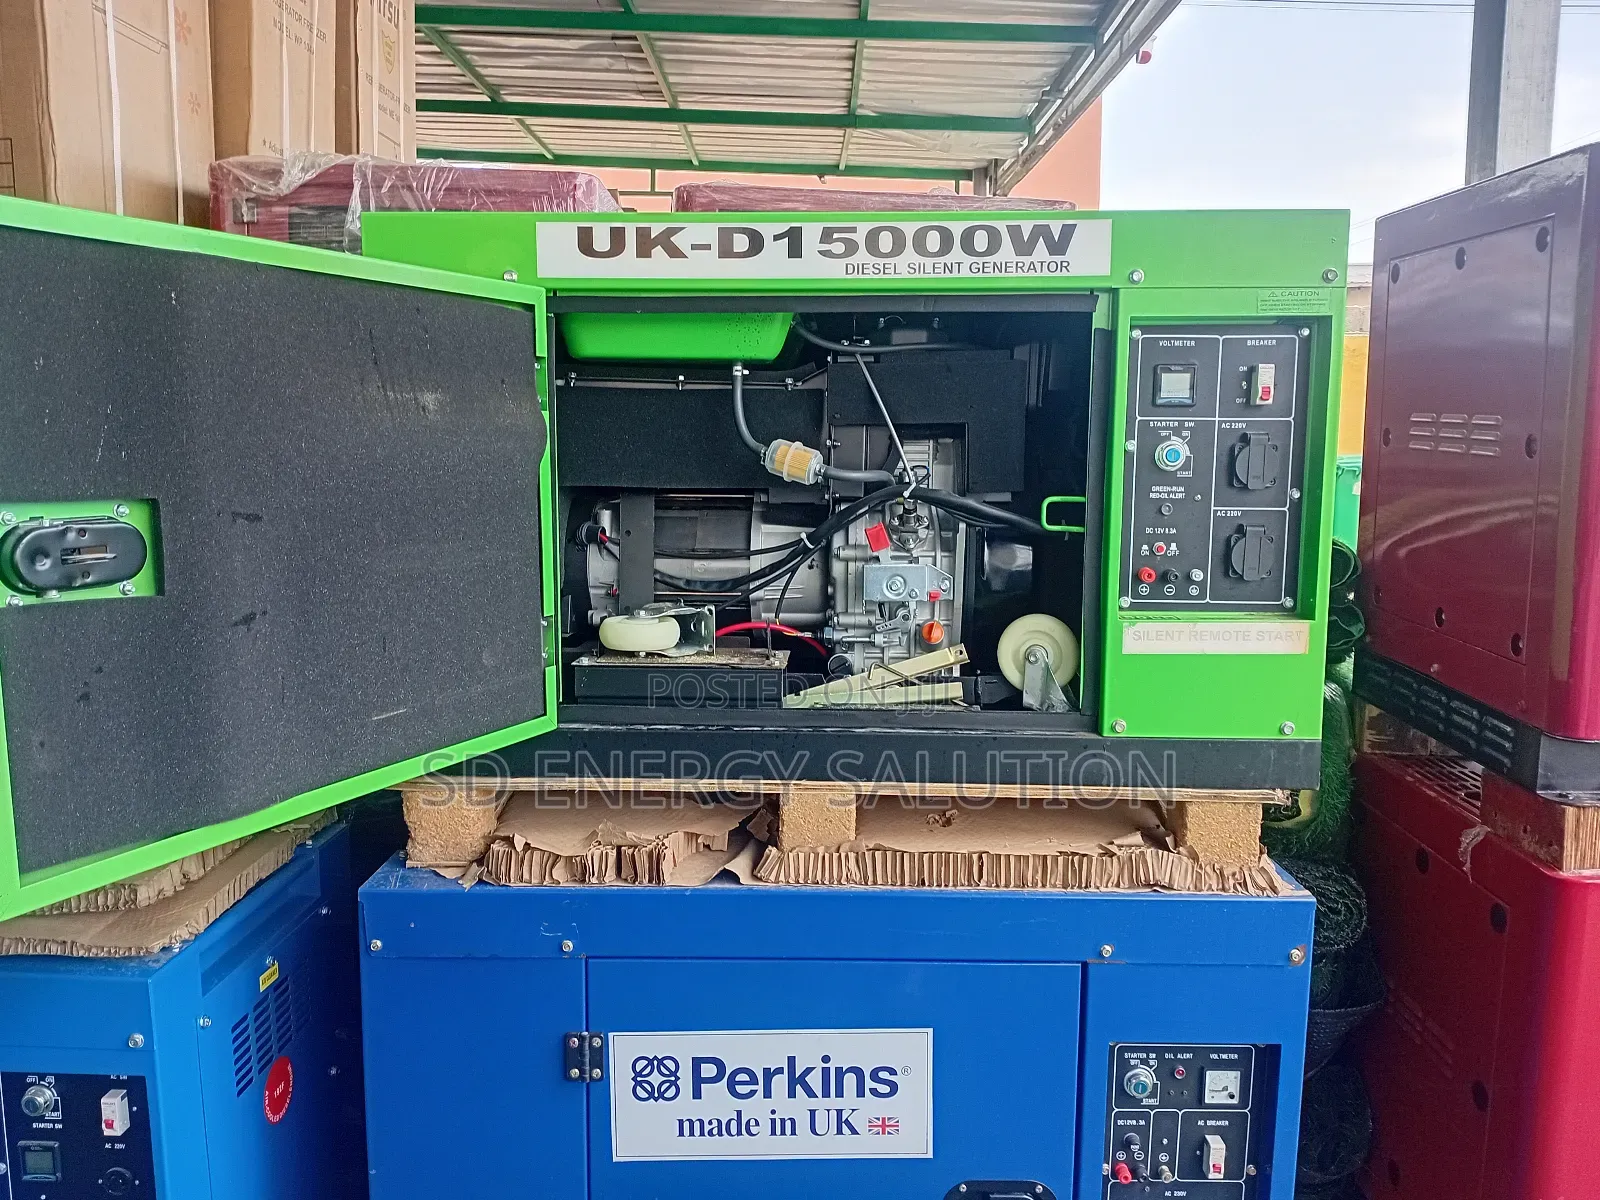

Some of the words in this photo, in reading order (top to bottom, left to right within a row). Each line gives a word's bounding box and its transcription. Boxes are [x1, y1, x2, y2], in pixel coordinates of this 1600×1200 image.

[576, 223, 1078, 260] UK-D15000W
[844, 262, 902, 276] DIESEL
[906, 261, 964, 275] SILENT
[968, 260, 1071, 274] GENERATOR
[1132, 630, 1184, 642] SILENT
[1188, 630, 1251, 642] REMOTE
[1255, 629, 1305, 641] START
[691, 1054, 899, 1101] Perkins
[676, 1109, 761, 1138] made
[768, 1108, 798, 1137] in
[807, 1108, 861, 1137] UK
